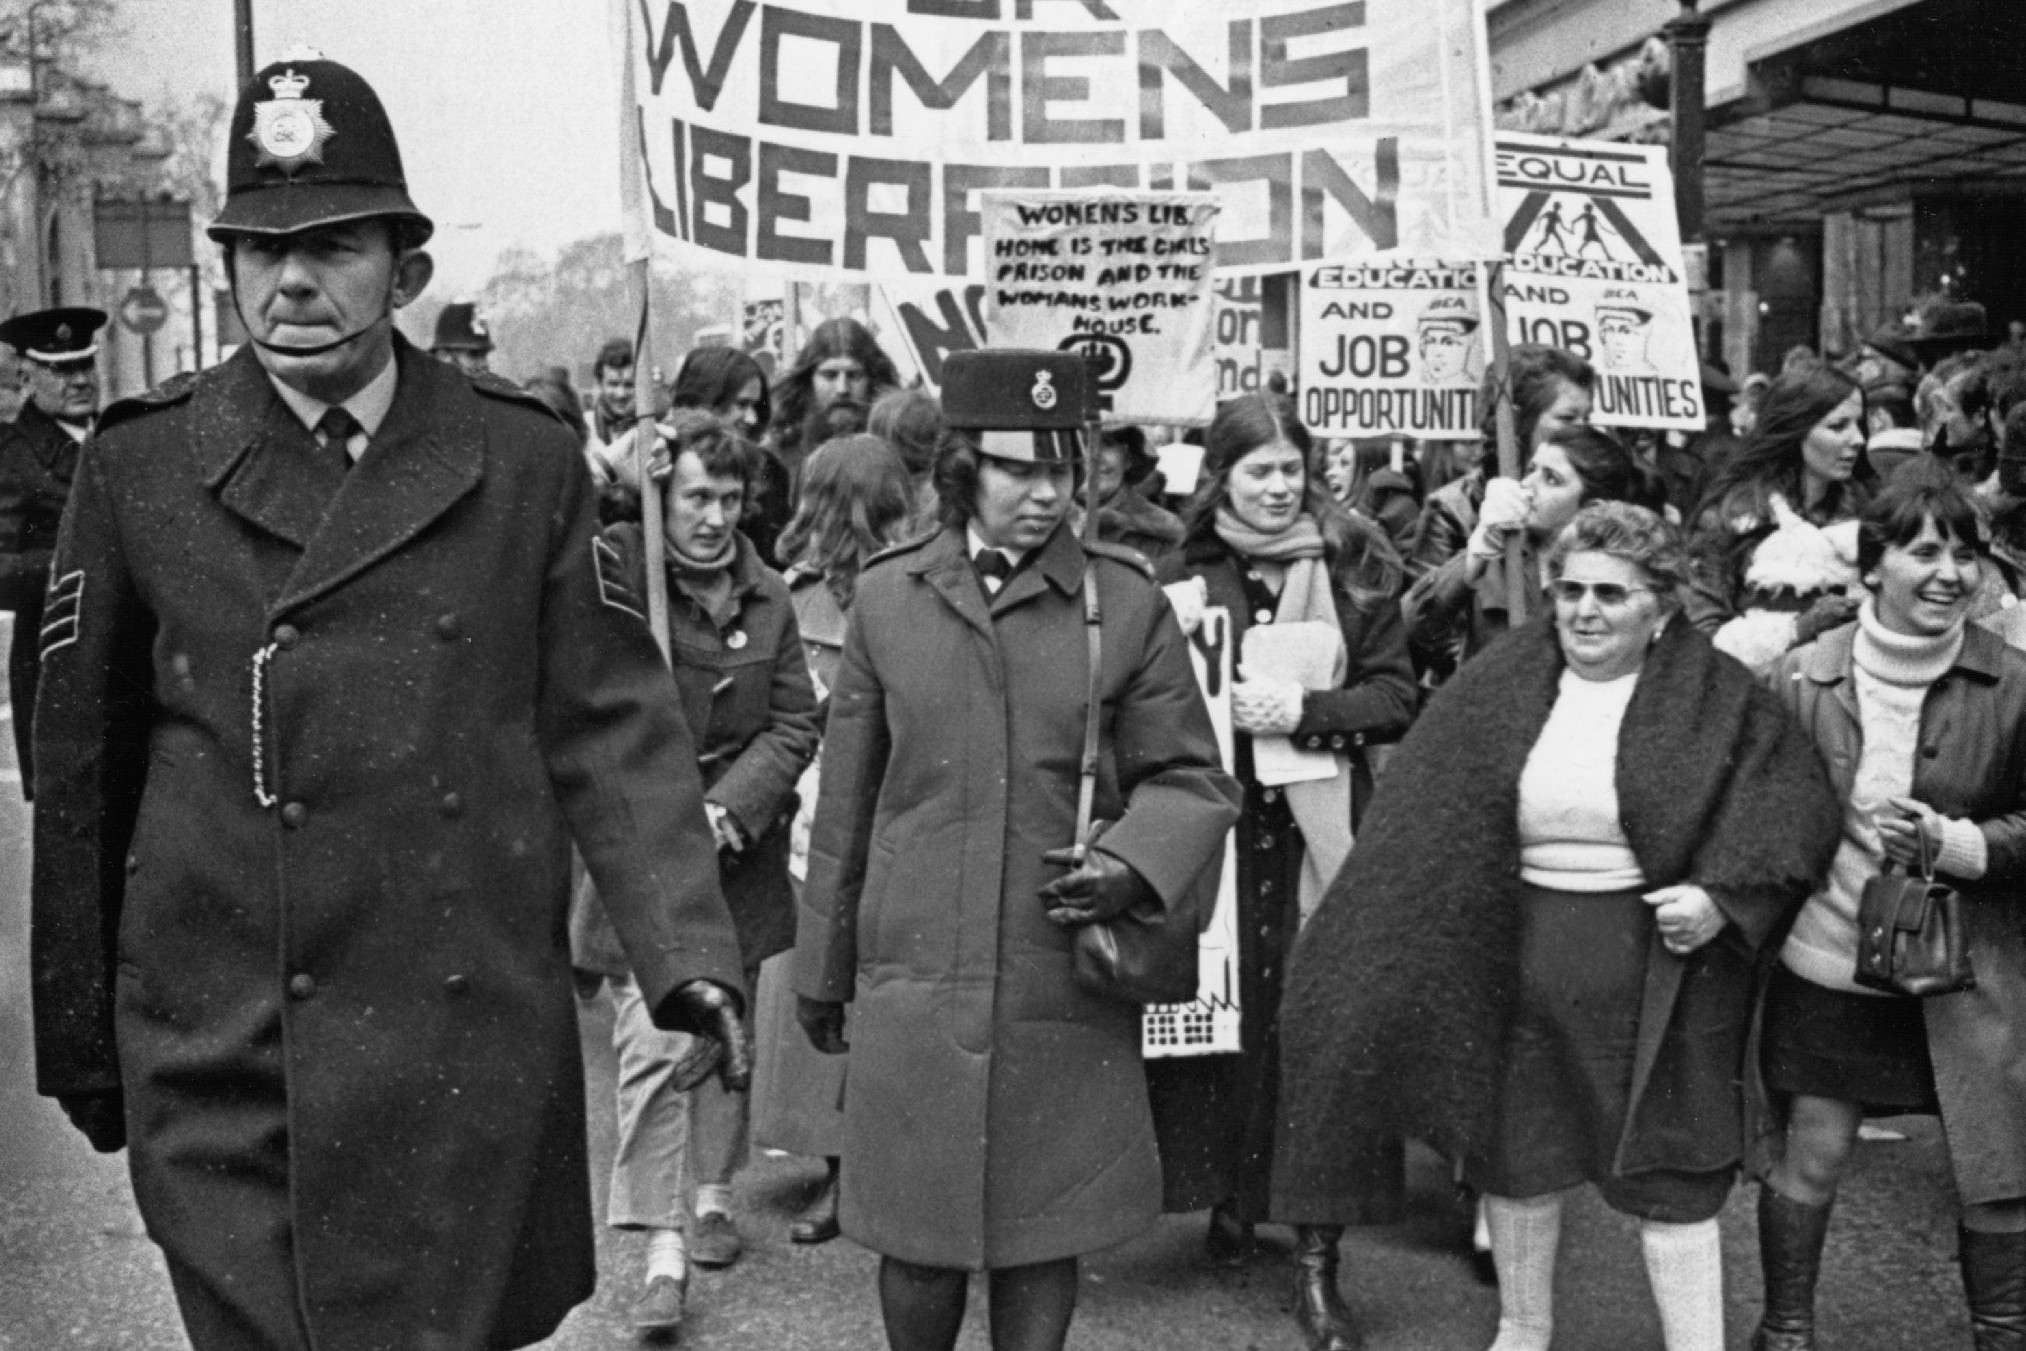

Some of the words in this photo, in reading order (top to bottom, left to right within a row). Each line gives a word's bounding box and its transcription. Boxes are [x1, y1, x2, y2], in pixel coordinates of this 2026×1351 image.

[640, 0, 1369, 144] WOMENS
[1496, 154, 1650, 188] EQUAL
[638, 104, 1398, 276] LIBERAON
[1017, 202, 1138, 226] WOMENS
[1149, 204, 1194, 226] LIB.
[995, 238, 1059, 256] HOME
[1071, 237, 1092, 255] IS
[1100, 236, 1148, 256] THE
[1153, 237, 1210, 256] GIRLS
[997, 263, 1085, 282] PRISON
[1097, 264, 1150, 286] AND
[1157, 264, 1201, 281] THE
[1319, 269, 1477, 288] EDUCATIO
[997, 290, 1100, 312] WOMANS
[1109, 292, 1200, 310] WORK-
[1504, 284, 1570, 304] AND
[1321, 302, 1394, 320] AND
[1073, 314, 1160, 335] HOUSE.
[1319, 334, 1411, 378] JOB
[1600, 374, 1698, 418] UNITIES
[1306, 386, 1478, 430] OPPORTUNITI
